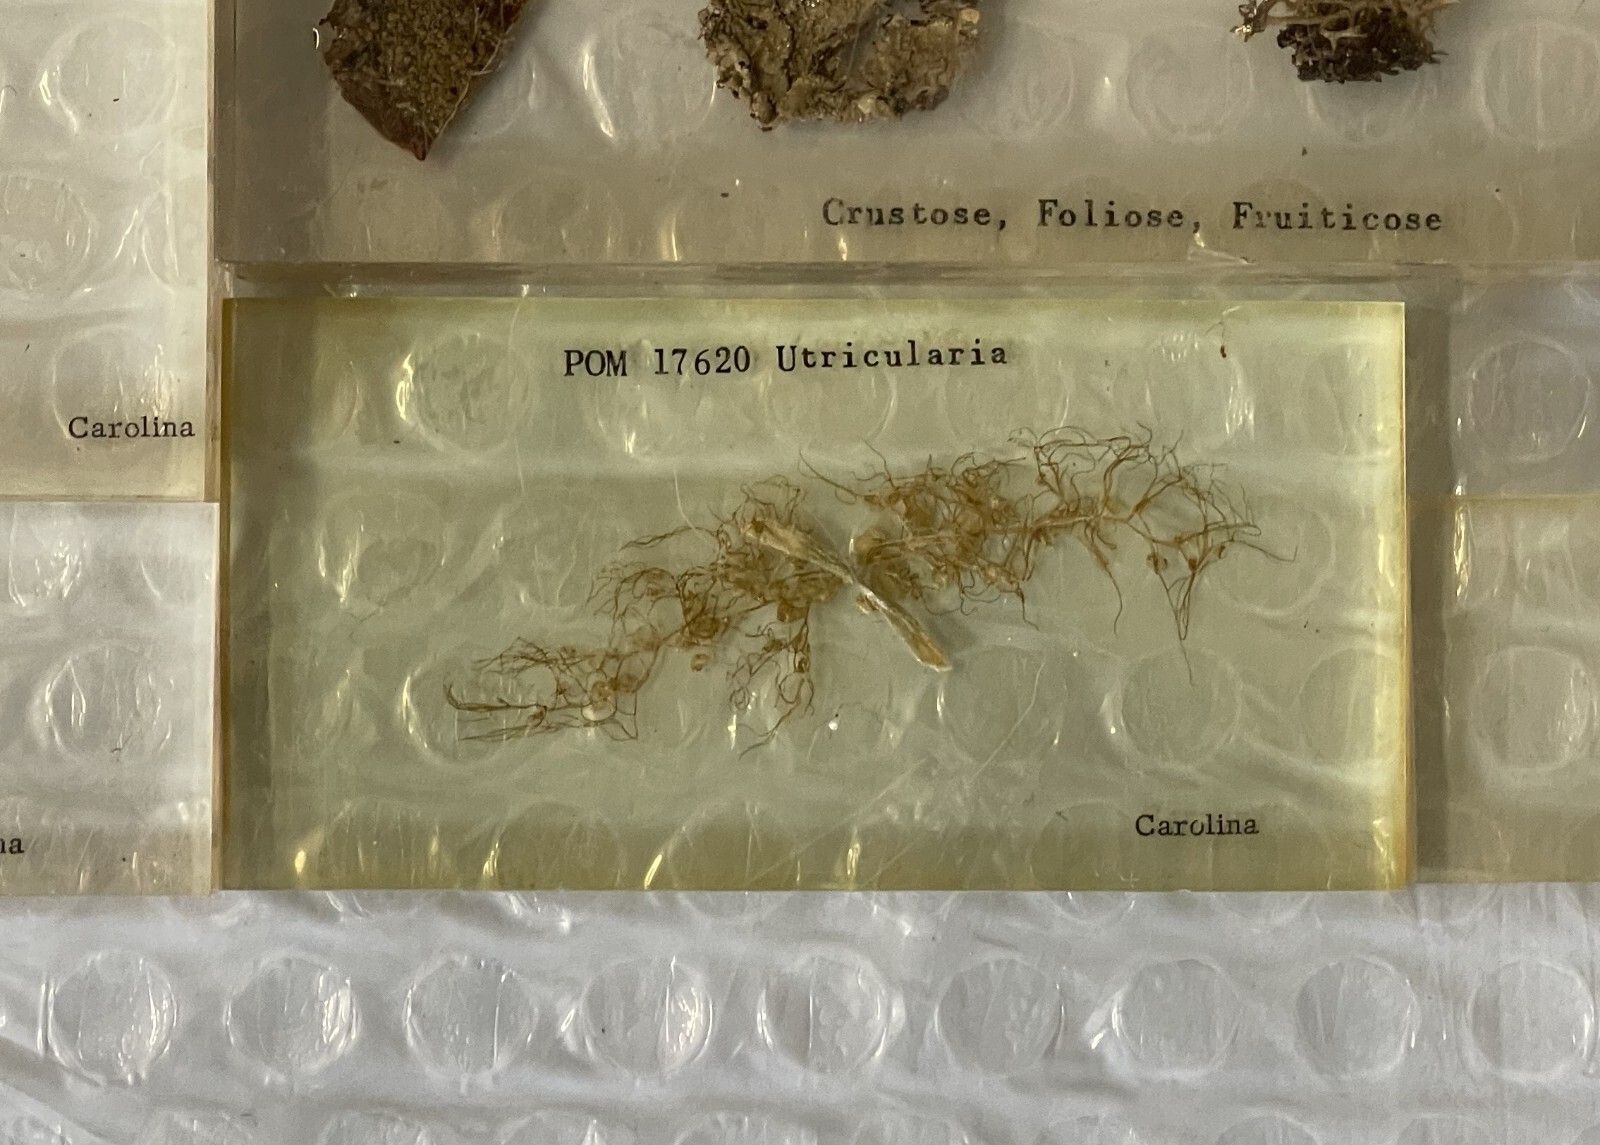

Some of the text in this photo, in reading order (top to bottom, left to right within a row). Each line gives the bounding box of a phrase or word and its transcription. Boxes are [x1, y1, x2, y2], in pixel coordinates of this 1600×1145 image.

[822, 197, 1443, 235] Crustose, Foliose, Fruiticose
[563, 338, 1008, 378] POM 17620 Utricularia
[68, 415, 196, 438] Carolina
[1135, 813, 1260, 837] Carolina
